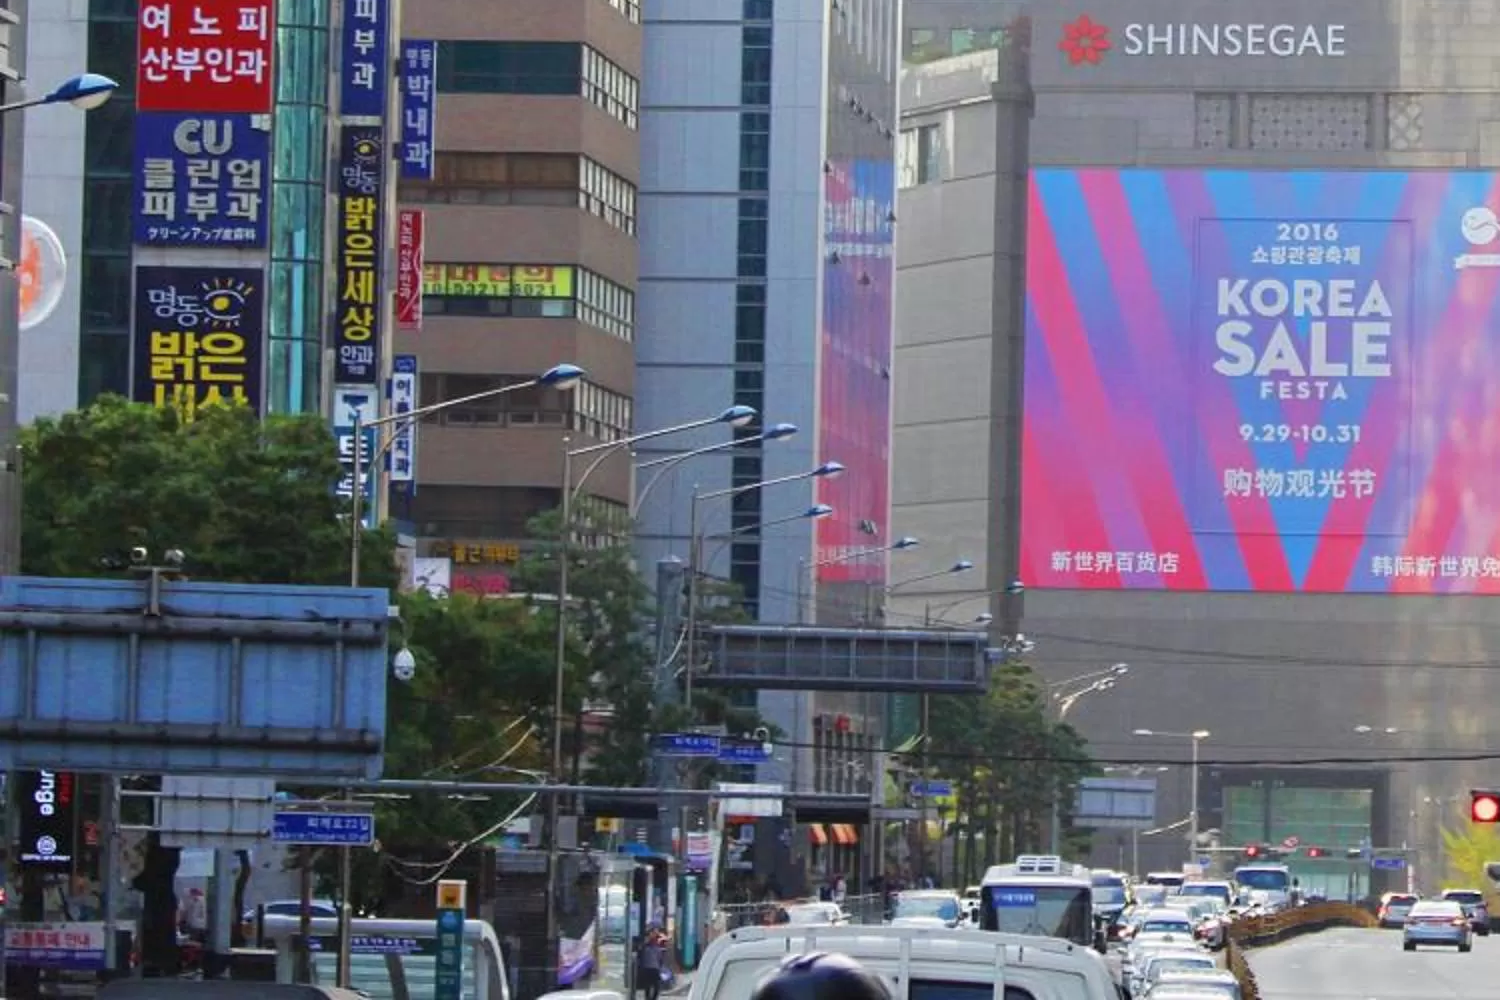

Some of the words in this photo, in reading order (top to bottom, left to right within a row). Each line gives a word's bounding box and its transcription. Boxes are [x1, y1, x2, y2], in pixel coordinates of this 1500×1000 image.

[1124, 23, 1346, 58] SHINSEGAE
[142, 47, 268, 84] 산부인과
[173, 119, 233, 155] CU
[405, 75, 432, 170] 박내과
[143, 158, 261, 189] 클린업
[141, 191, 262, 221] 피부과
[1277, 223, 1339, 241] 2016
[342, 197, 377, 341] 밝은세상
[1252, 245, 1361, 266] 쇼핑관광축제
[146, 285, 203, 327] 명동
[1217, 278, 1393, 318] KOREA
[151, 331, 248, 381] 밝은
[1213, 319, 1392, 377] SALE
[1260, 381, 1348, 400] FESTA
[1239, 424, 1361, 443] 9.29-10.31
[1224, 467, 1377, 499] 购物观光节
[1052, 551, 1180, 573] 新世界百货店
